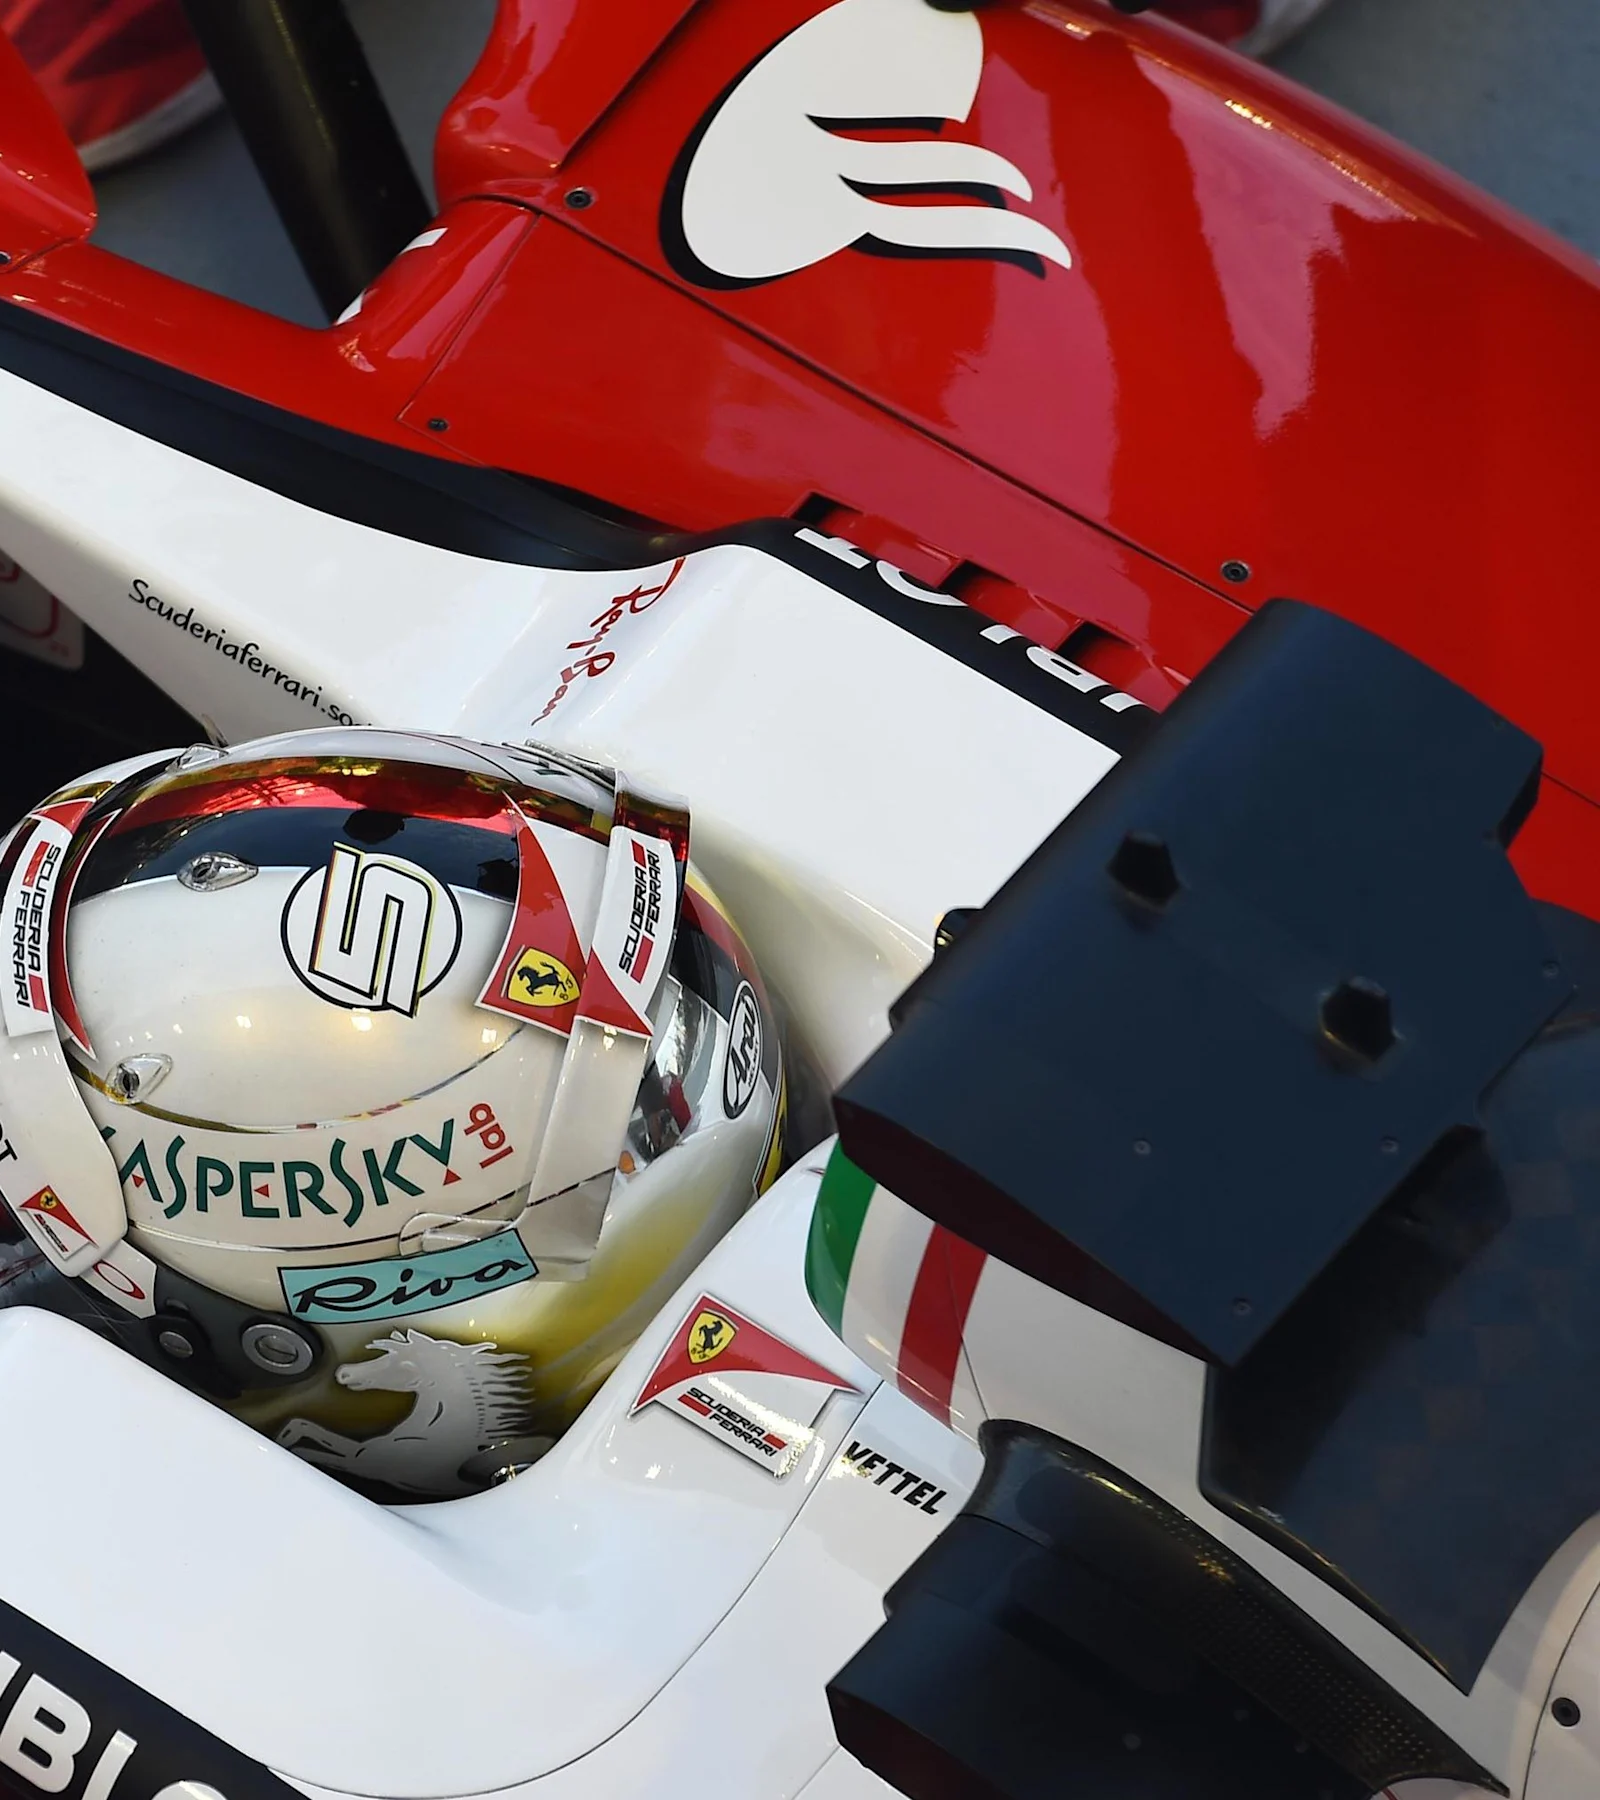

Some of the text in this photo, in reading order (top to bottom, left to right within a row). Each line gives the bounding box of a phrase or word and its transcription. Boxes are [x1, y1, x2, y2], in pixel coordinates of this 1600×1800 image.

[128, 578, 373, 727] Scuderiaferrari.so
[531, 556, 687, 727] Ray-Ban
[13, 889, 31, 1008] FERRARI
[28, 844, 62, 973] SCUDERIA
[309, 841, 436, 1019] 5
[618, 866, 647, 974] SCUDERIA
[645, 849, 660, 938] FERRARI
[730, 994, 756, 1112] Arai
[99, 1102, 514, 1228] ASPERSKY lab
[294, 1256, 530, 1314] Riva
[687, 1387, 765, 1438] SCUDERIA
[707, 1407, 777, 1458] FERRARI
[844, 1440, 947, 1516] VETTEL
